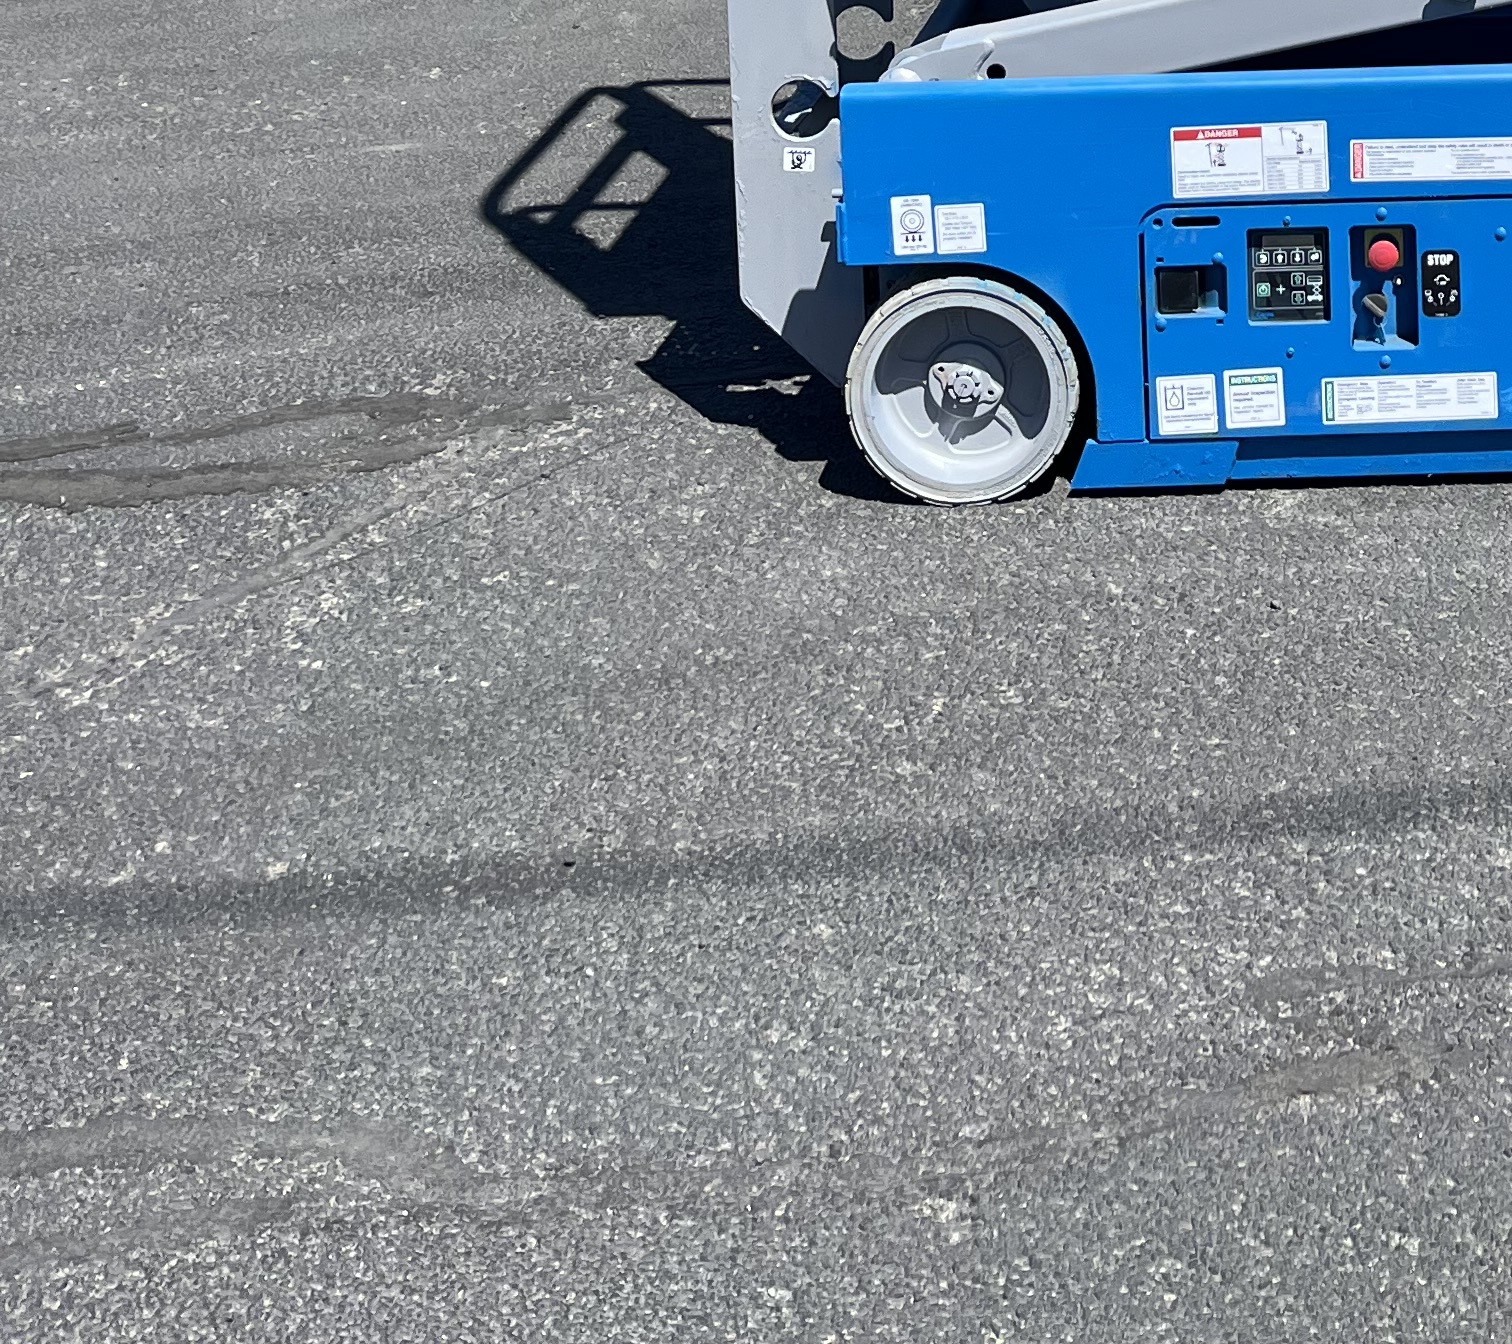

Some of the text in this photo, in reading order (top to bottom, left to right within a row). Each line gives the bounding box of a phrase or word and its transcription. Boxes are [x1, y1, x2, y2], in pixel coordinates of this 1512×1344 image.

[1204, 129, 1239, 138] DANGER
[1427, 253, 1454, 266] STOP
[1230, 374, 1276, 385] INSTRUCTIONS
